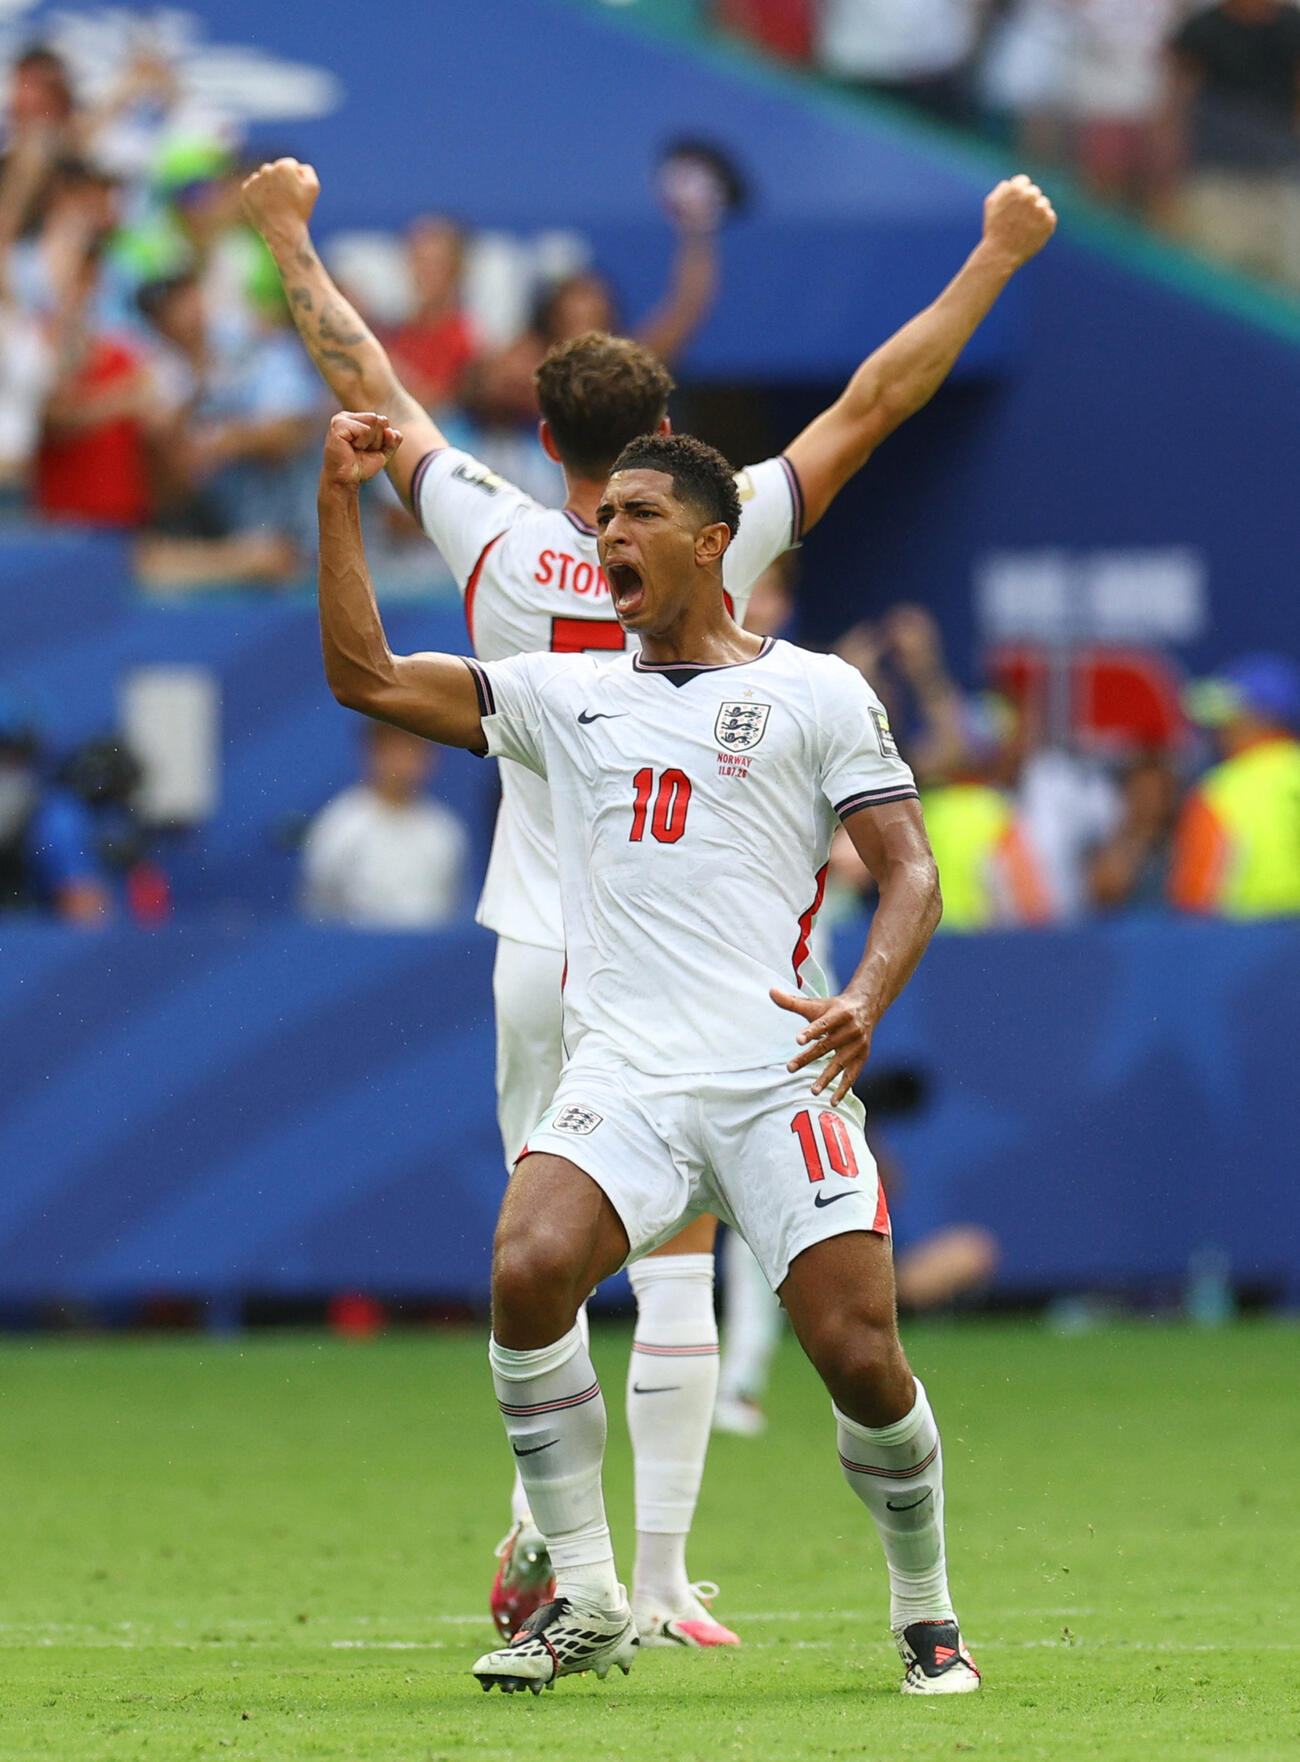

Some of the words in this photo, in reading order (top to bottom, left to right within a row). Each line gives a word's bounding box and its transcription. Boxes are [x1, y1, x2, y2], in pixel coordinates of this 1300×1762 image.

[717, 753, 752, 767] NORWAY
[629, 768, 692, 844] 10
[790, 1110, 858, 1183] 10
